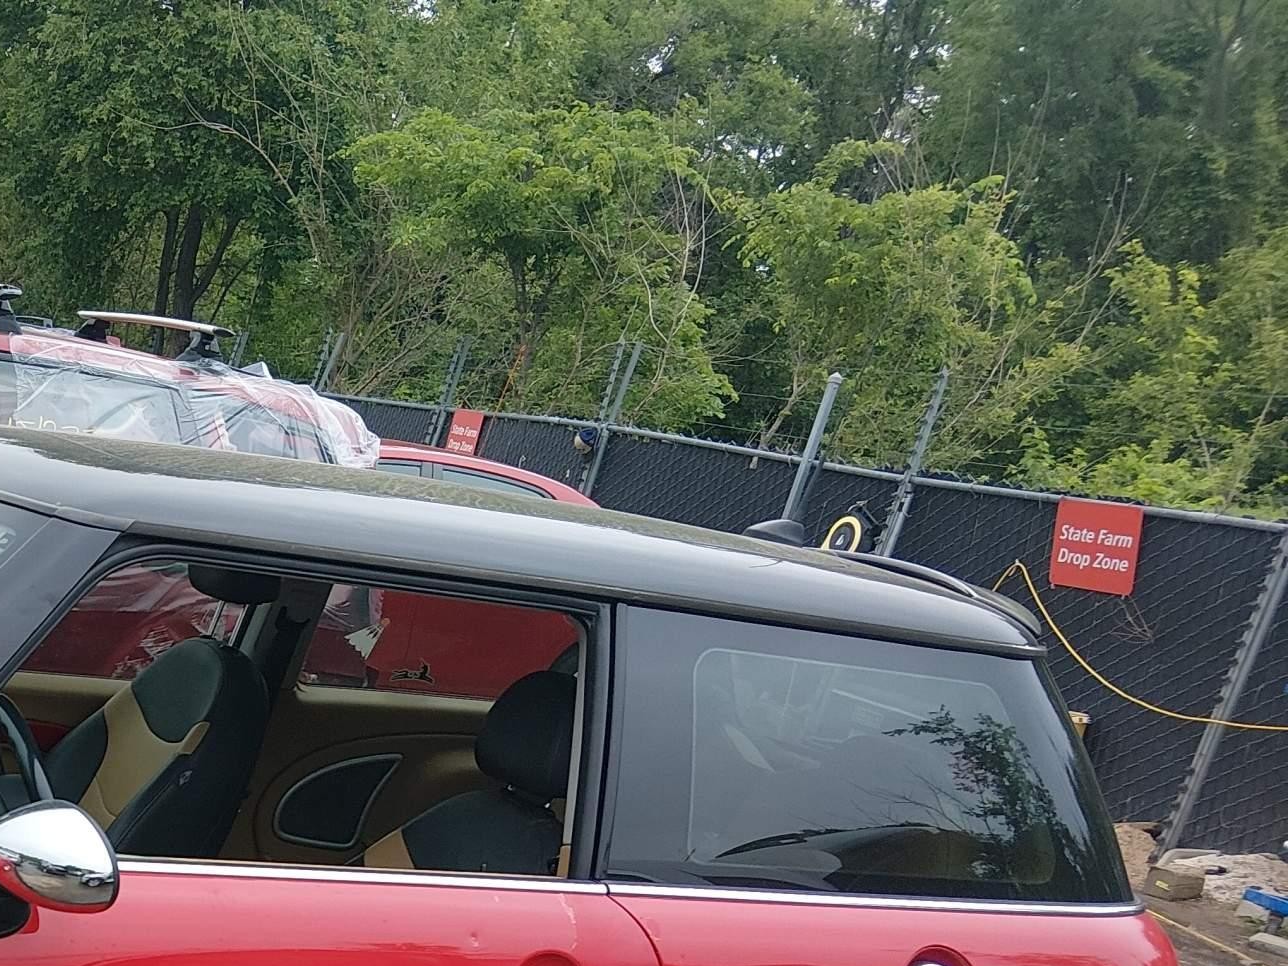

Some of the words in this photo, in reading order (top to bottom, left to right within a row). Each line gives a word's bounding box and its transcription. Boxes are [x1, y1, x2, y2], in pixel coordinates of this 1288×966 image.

[1060, 525, 1095, 543] State
[1098, 530, 1133, 548] Farm
[1058, 548, 1090, 569] Drop
[1093, 554, 1129, 572] Zone
